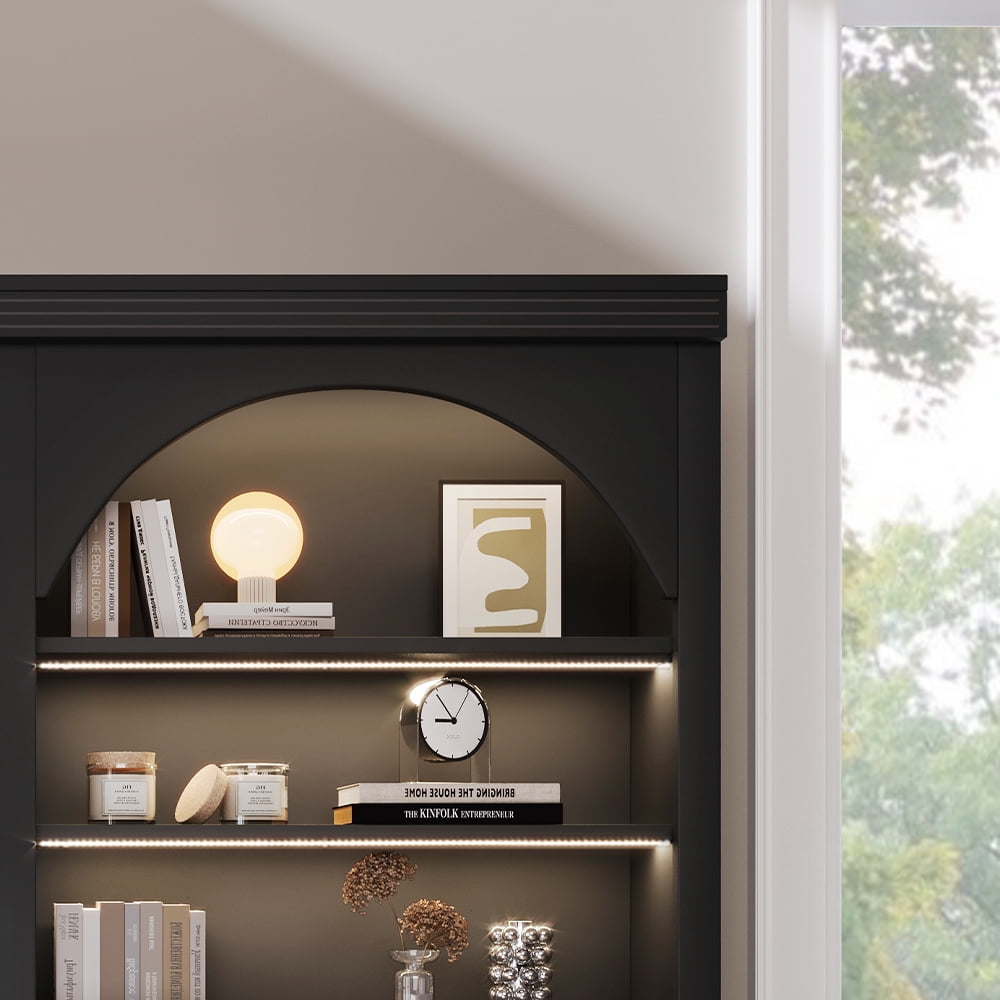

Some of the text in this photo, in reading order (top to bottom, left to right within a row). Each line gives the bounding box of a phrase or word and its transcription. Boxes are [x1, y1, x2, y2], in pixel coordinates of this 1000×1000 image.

[404, 808, 514, 818] THE KINFOLK ENTREPRENEUR
